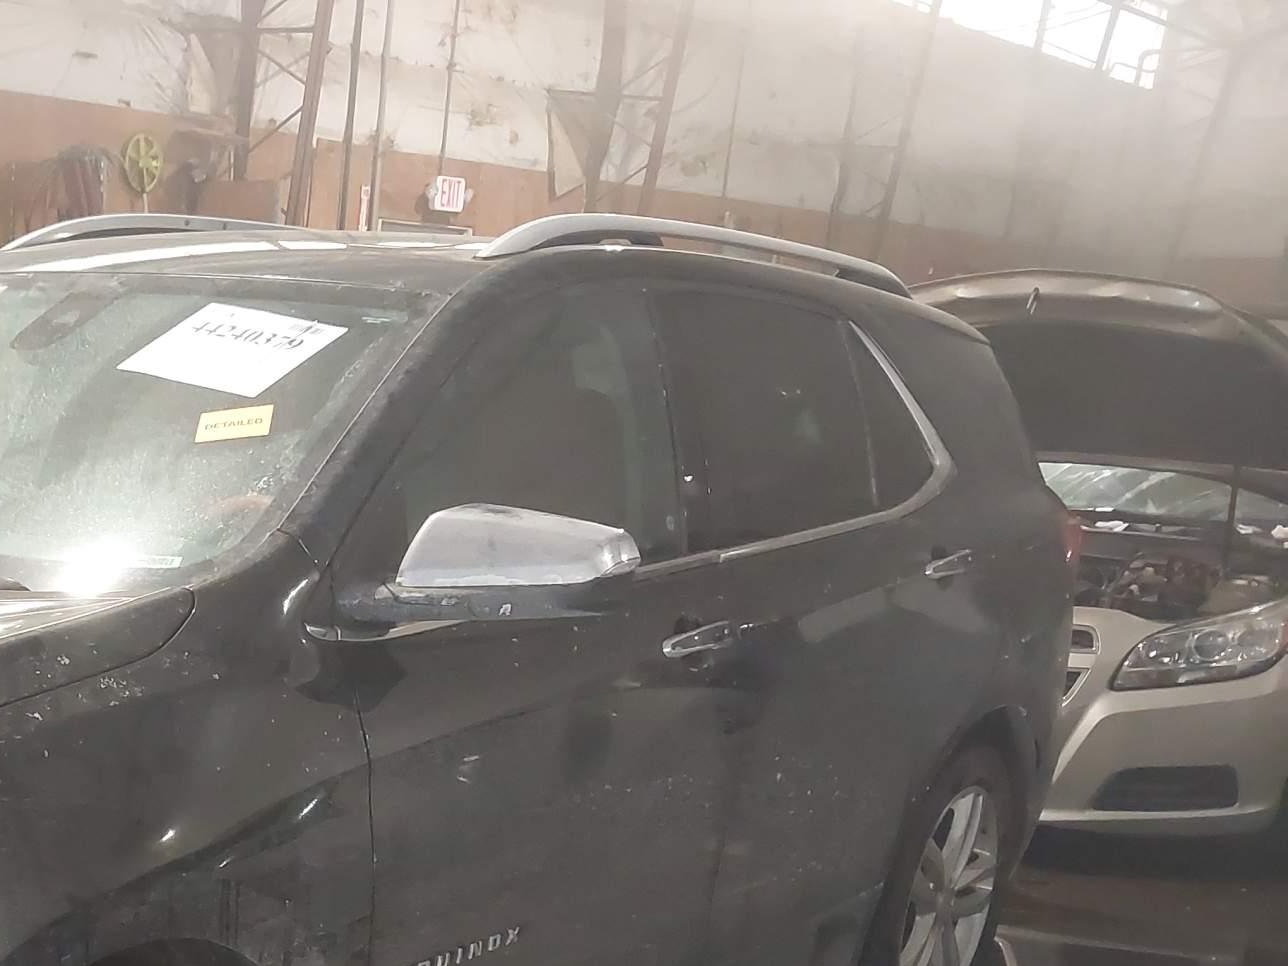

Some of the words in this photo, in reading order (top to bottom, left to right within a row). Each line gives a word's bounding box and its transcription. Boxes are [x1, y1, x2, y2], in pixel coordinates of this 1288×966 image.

[440, 179, 462, 208] EXIT
[192, 321, 305, 350] 44240379
[204, 417, 264, 431] DETAILED
